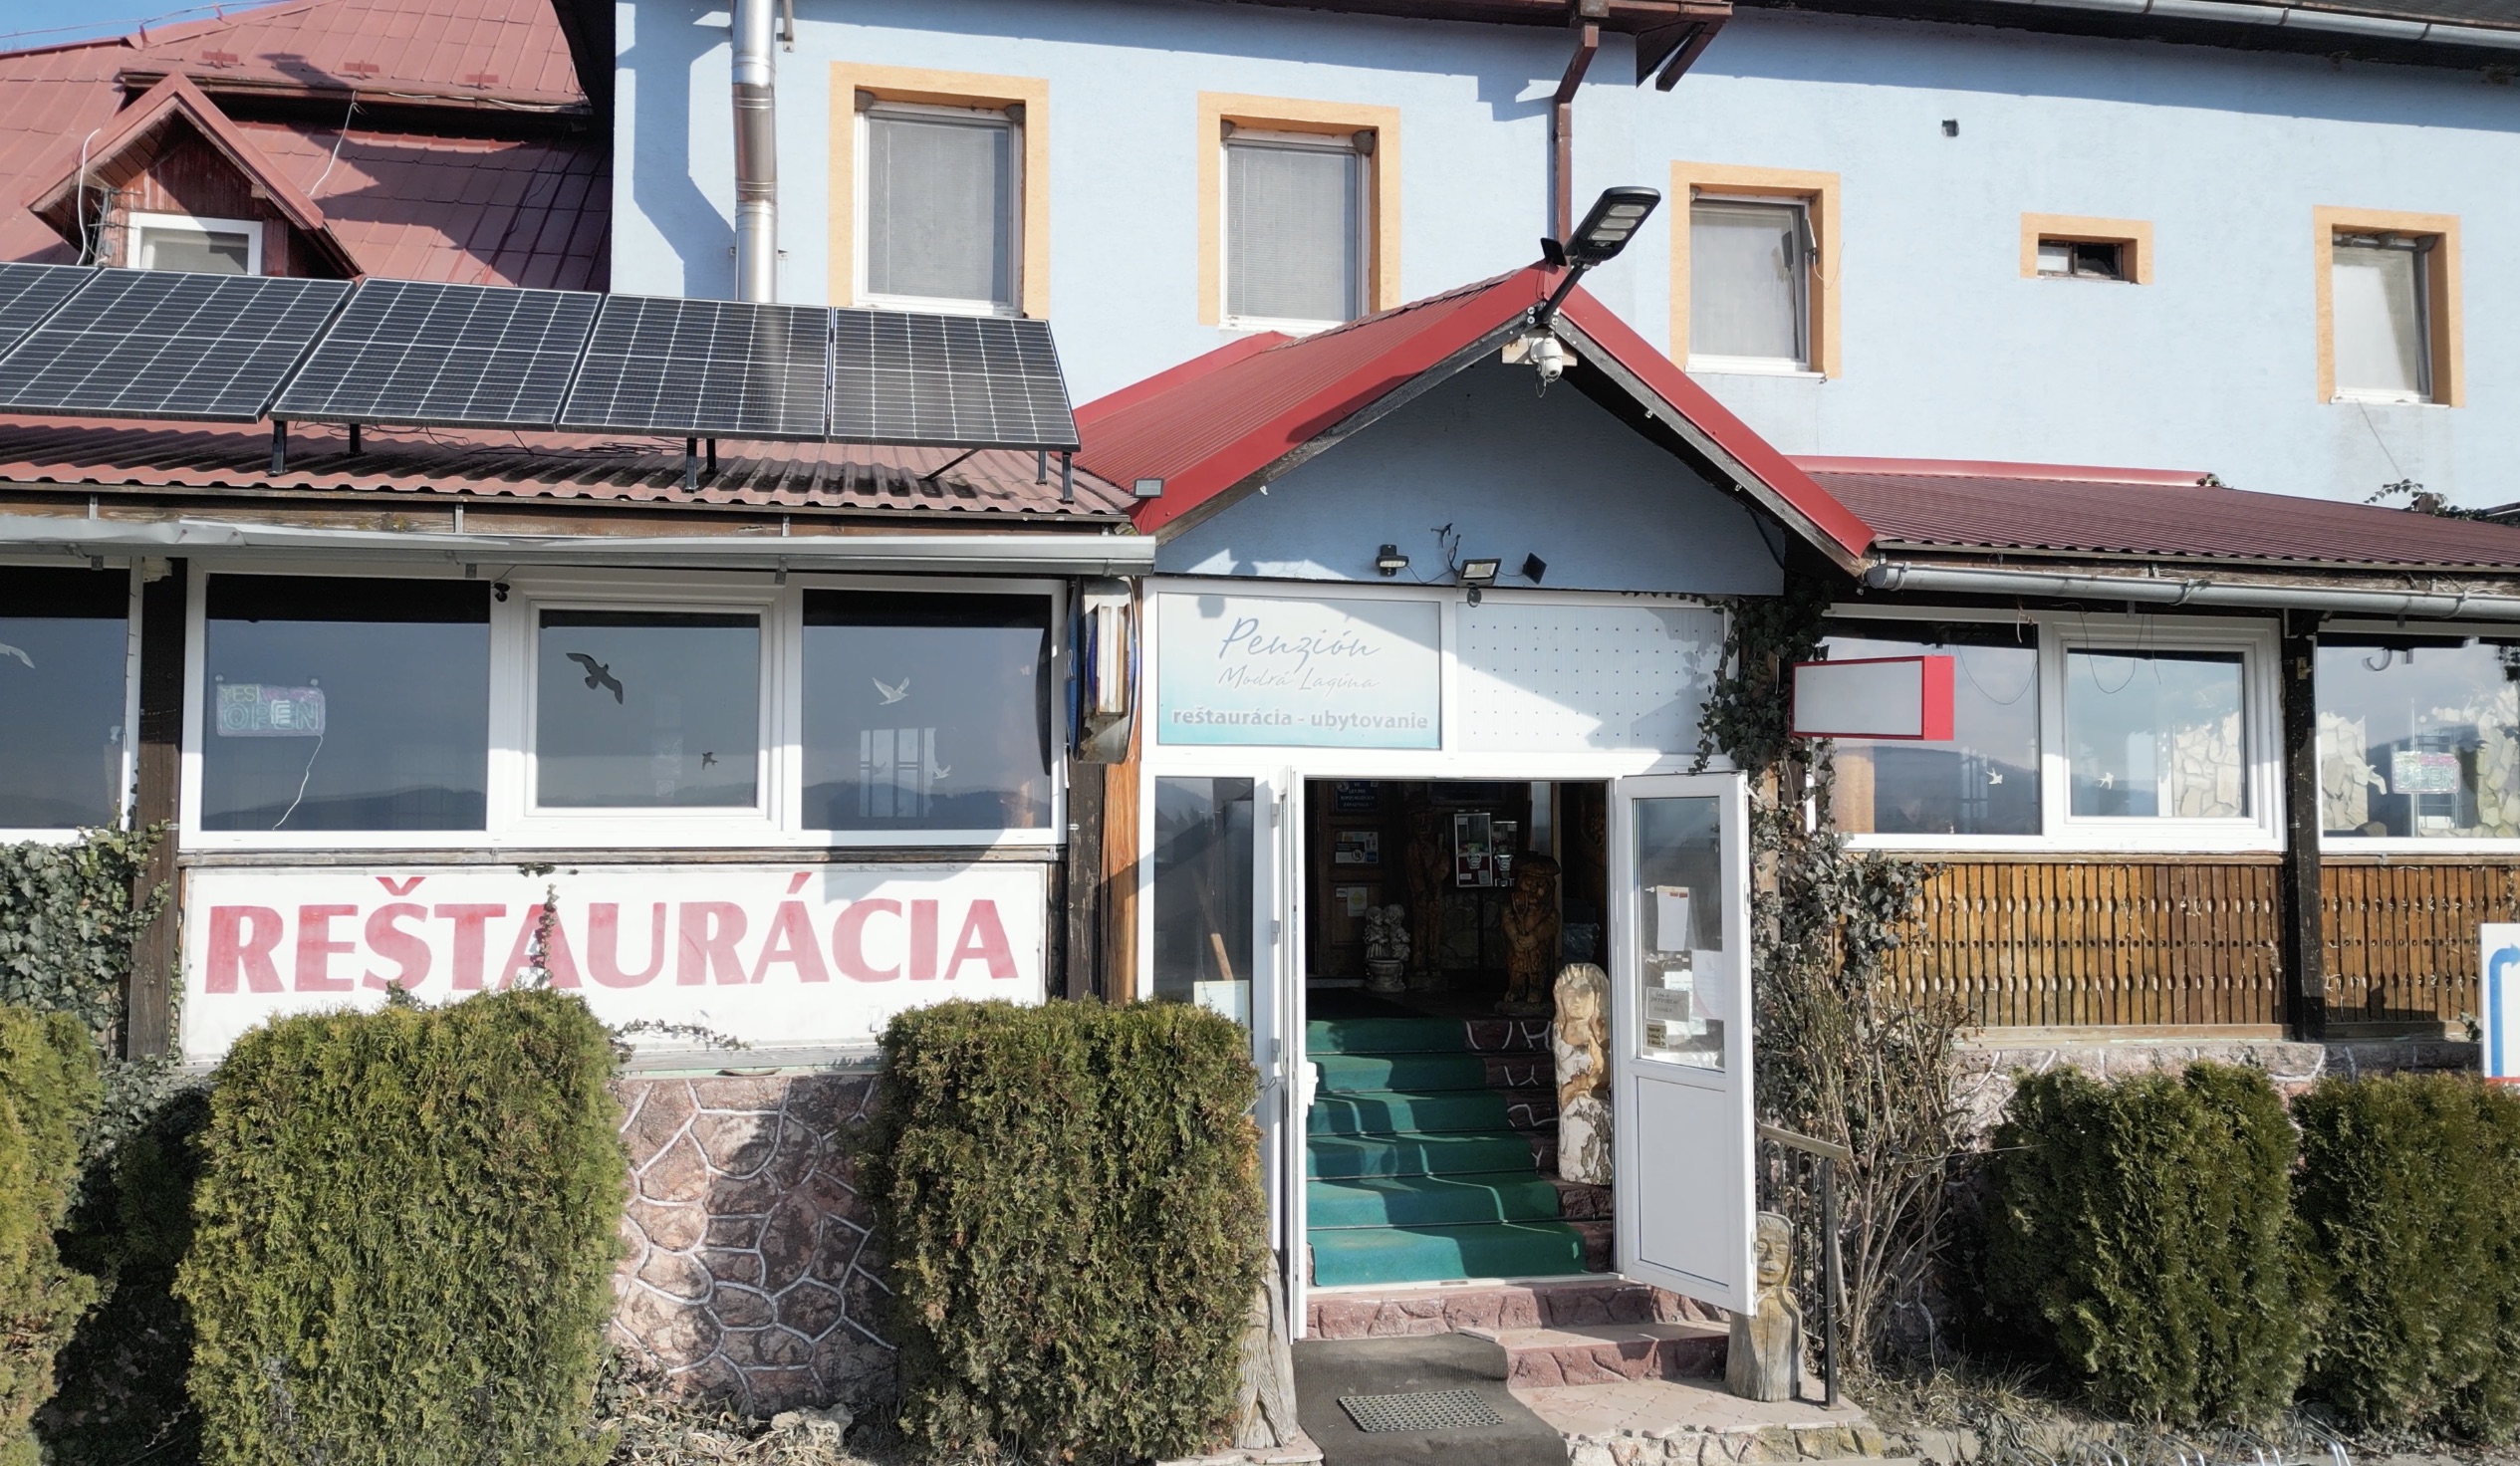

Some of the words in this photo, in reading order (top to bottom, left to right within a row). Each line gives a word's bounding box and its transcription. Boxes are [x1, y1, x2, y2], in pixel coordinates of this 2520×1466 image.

[1218, 617, 1381, 672] Penzión
[1218, 664, 1294, 689] Modrá
[224, 702, 318, 731] OPEN
[1172, 705, 1293, 726] reštaurácia
[1311, 709, 1428, 732] ubytovanie
[205, 872, 1019, 994] REŠTAURÁCIA
